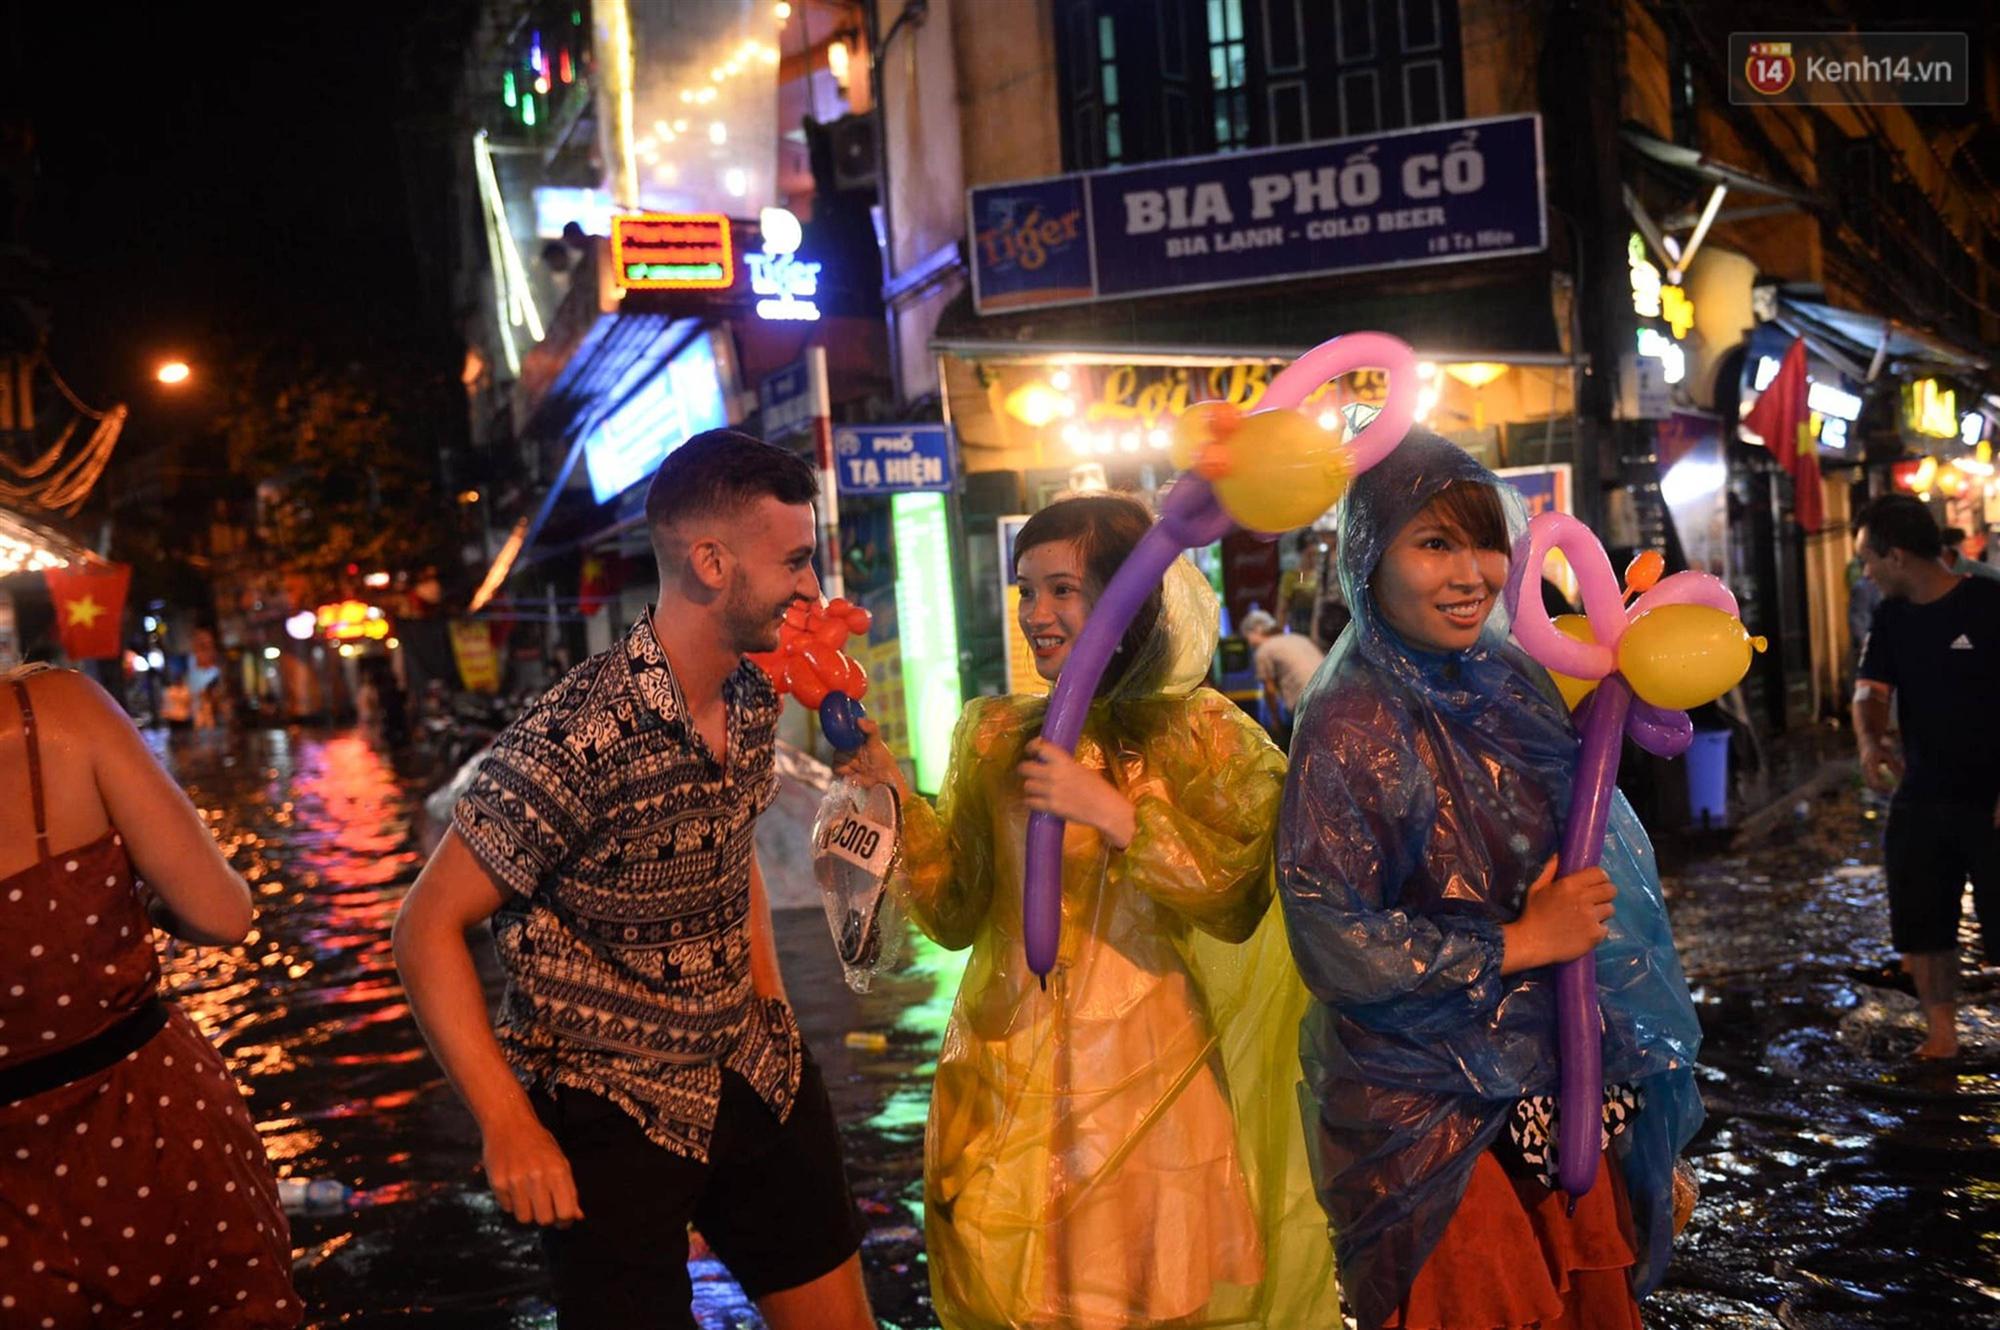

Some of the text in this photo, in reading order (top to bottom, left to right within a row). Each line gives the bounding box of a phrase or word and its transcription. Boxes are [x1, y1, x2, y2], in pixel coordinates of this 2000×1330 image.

[1124, 129, 1485, 236] BIA PHỐ CỔ
[976, 207, 1081, 270] Tiger
[1166, 236, 1208, 258] BIA
[1307, 215, 1371, 241] COLD
[1377, 206, 1446, 233] BEER
[872, 431, 915, 453] PHỐ
[848, 452, 943, 488] TẠ HIỆN
